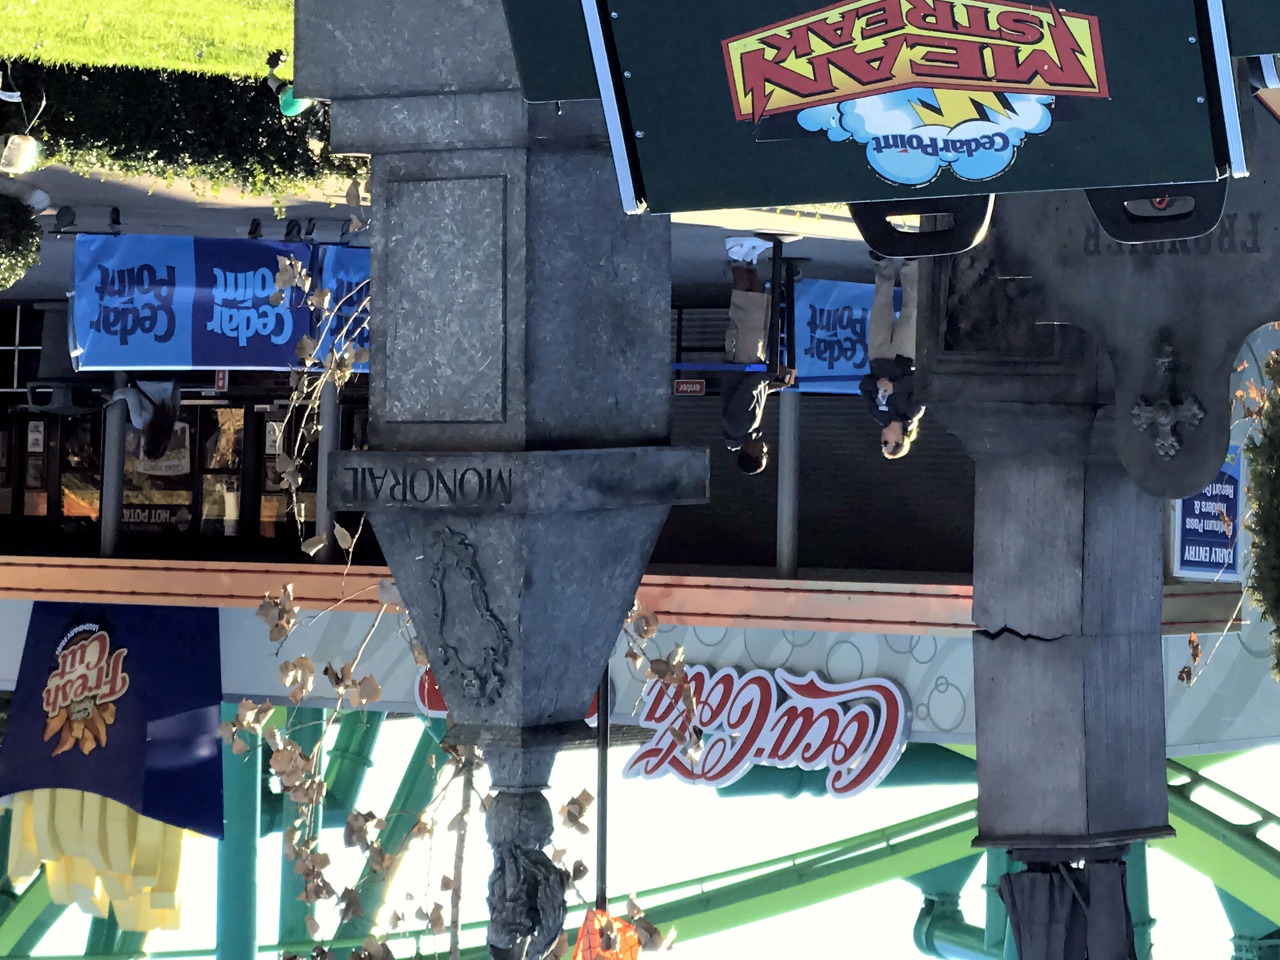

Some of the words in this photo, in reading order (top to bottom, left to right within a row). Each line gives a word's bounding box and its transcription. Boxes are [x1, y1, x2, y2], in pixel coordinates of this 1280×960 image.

[739, 0, 1096, 125] MEAN
[94, 264, 176, 307] Point
[89, 302, 176, 346] Cedar
[206, 306, 293, 347] Cedar
[806, 304, 868, 342] Point
[804, 334, 868, 369] Cedar
[678, 383, 701, 393] enter
[343, 467, 512, 504] MONORAIL
[122, 508, 149, 523] POTA
[150, 509, 170, 523] HOT
[1185, 517, 1204, 533] Pass
[1193, 500, 1201, 515] &
[1183, 545, 1209, 561] ENTRY
[1210, 547, 1233, 564] EARLY
[49, 632, 108, 680] Cut
[44, 649, 128, 713] Fresh
[626, 670, 900, 795] Coca-Cola
